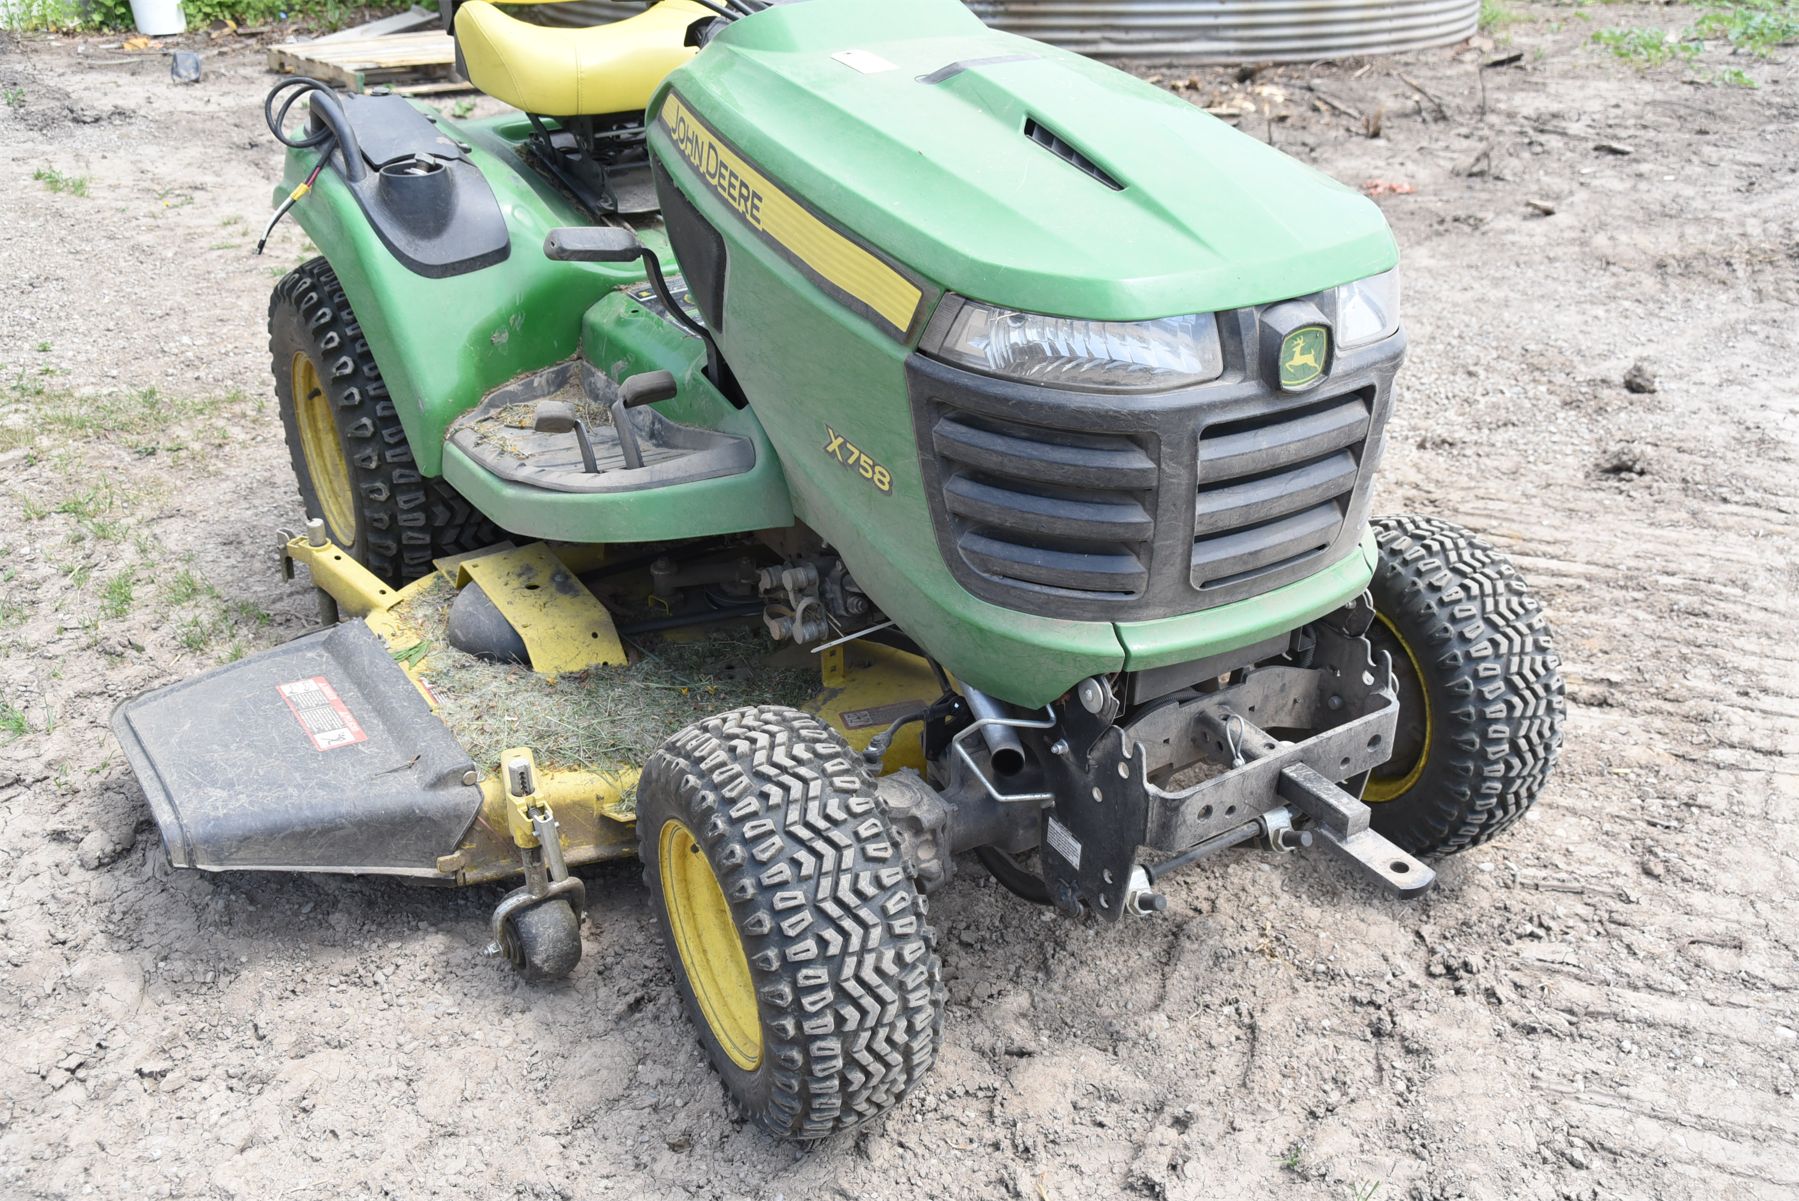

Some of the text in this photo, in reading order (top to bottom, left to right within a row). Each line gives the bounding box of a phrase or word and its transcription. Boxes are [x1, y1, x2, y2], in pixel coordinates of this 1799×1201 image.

[671, 105, 763, 225] JOHN DEERE
[824, 425, 892, 493] X758
